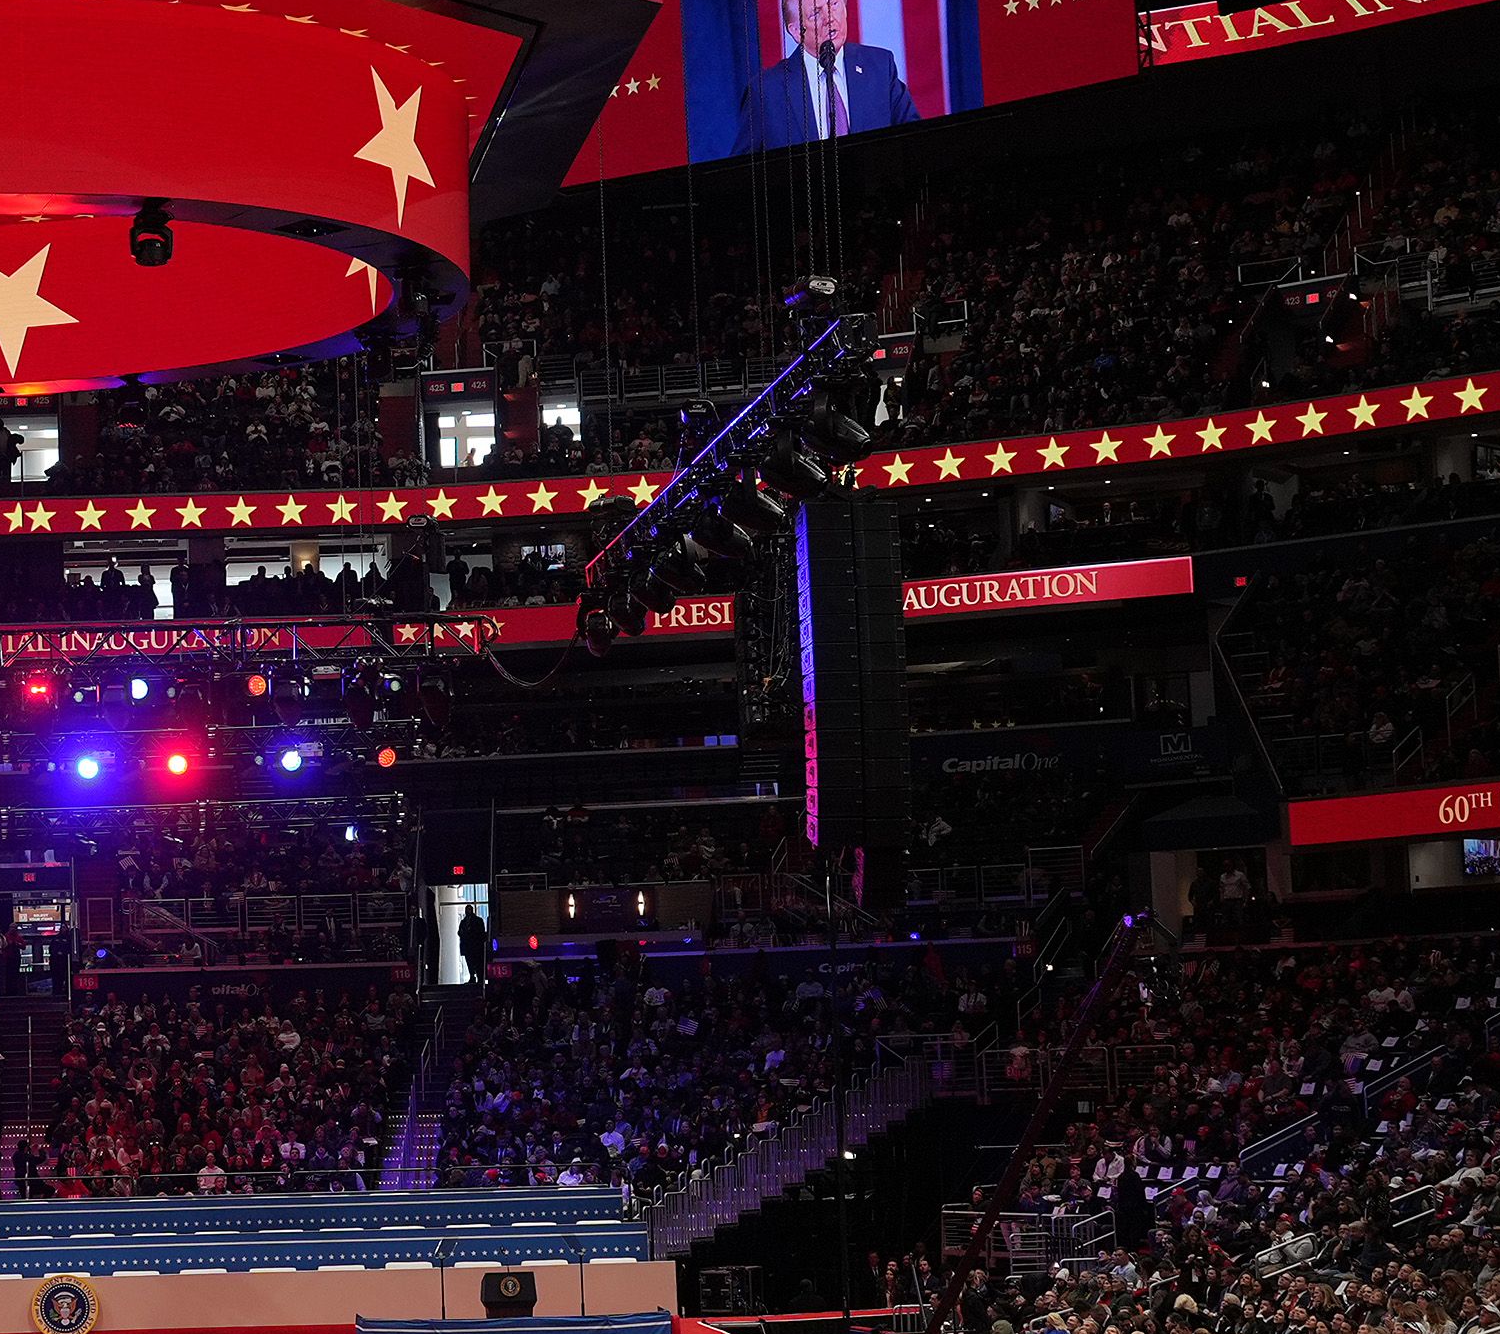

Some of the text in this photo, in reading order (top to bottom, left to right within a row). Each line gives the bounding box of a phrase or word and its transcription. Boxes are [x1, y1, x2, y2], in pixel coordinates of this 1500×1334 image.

[653, 570, 1098, 629] PRESI AUGURATION
[58, 628, 281, 651] INAUGURAON
[1438, 792, 1493, 825] 60TH
